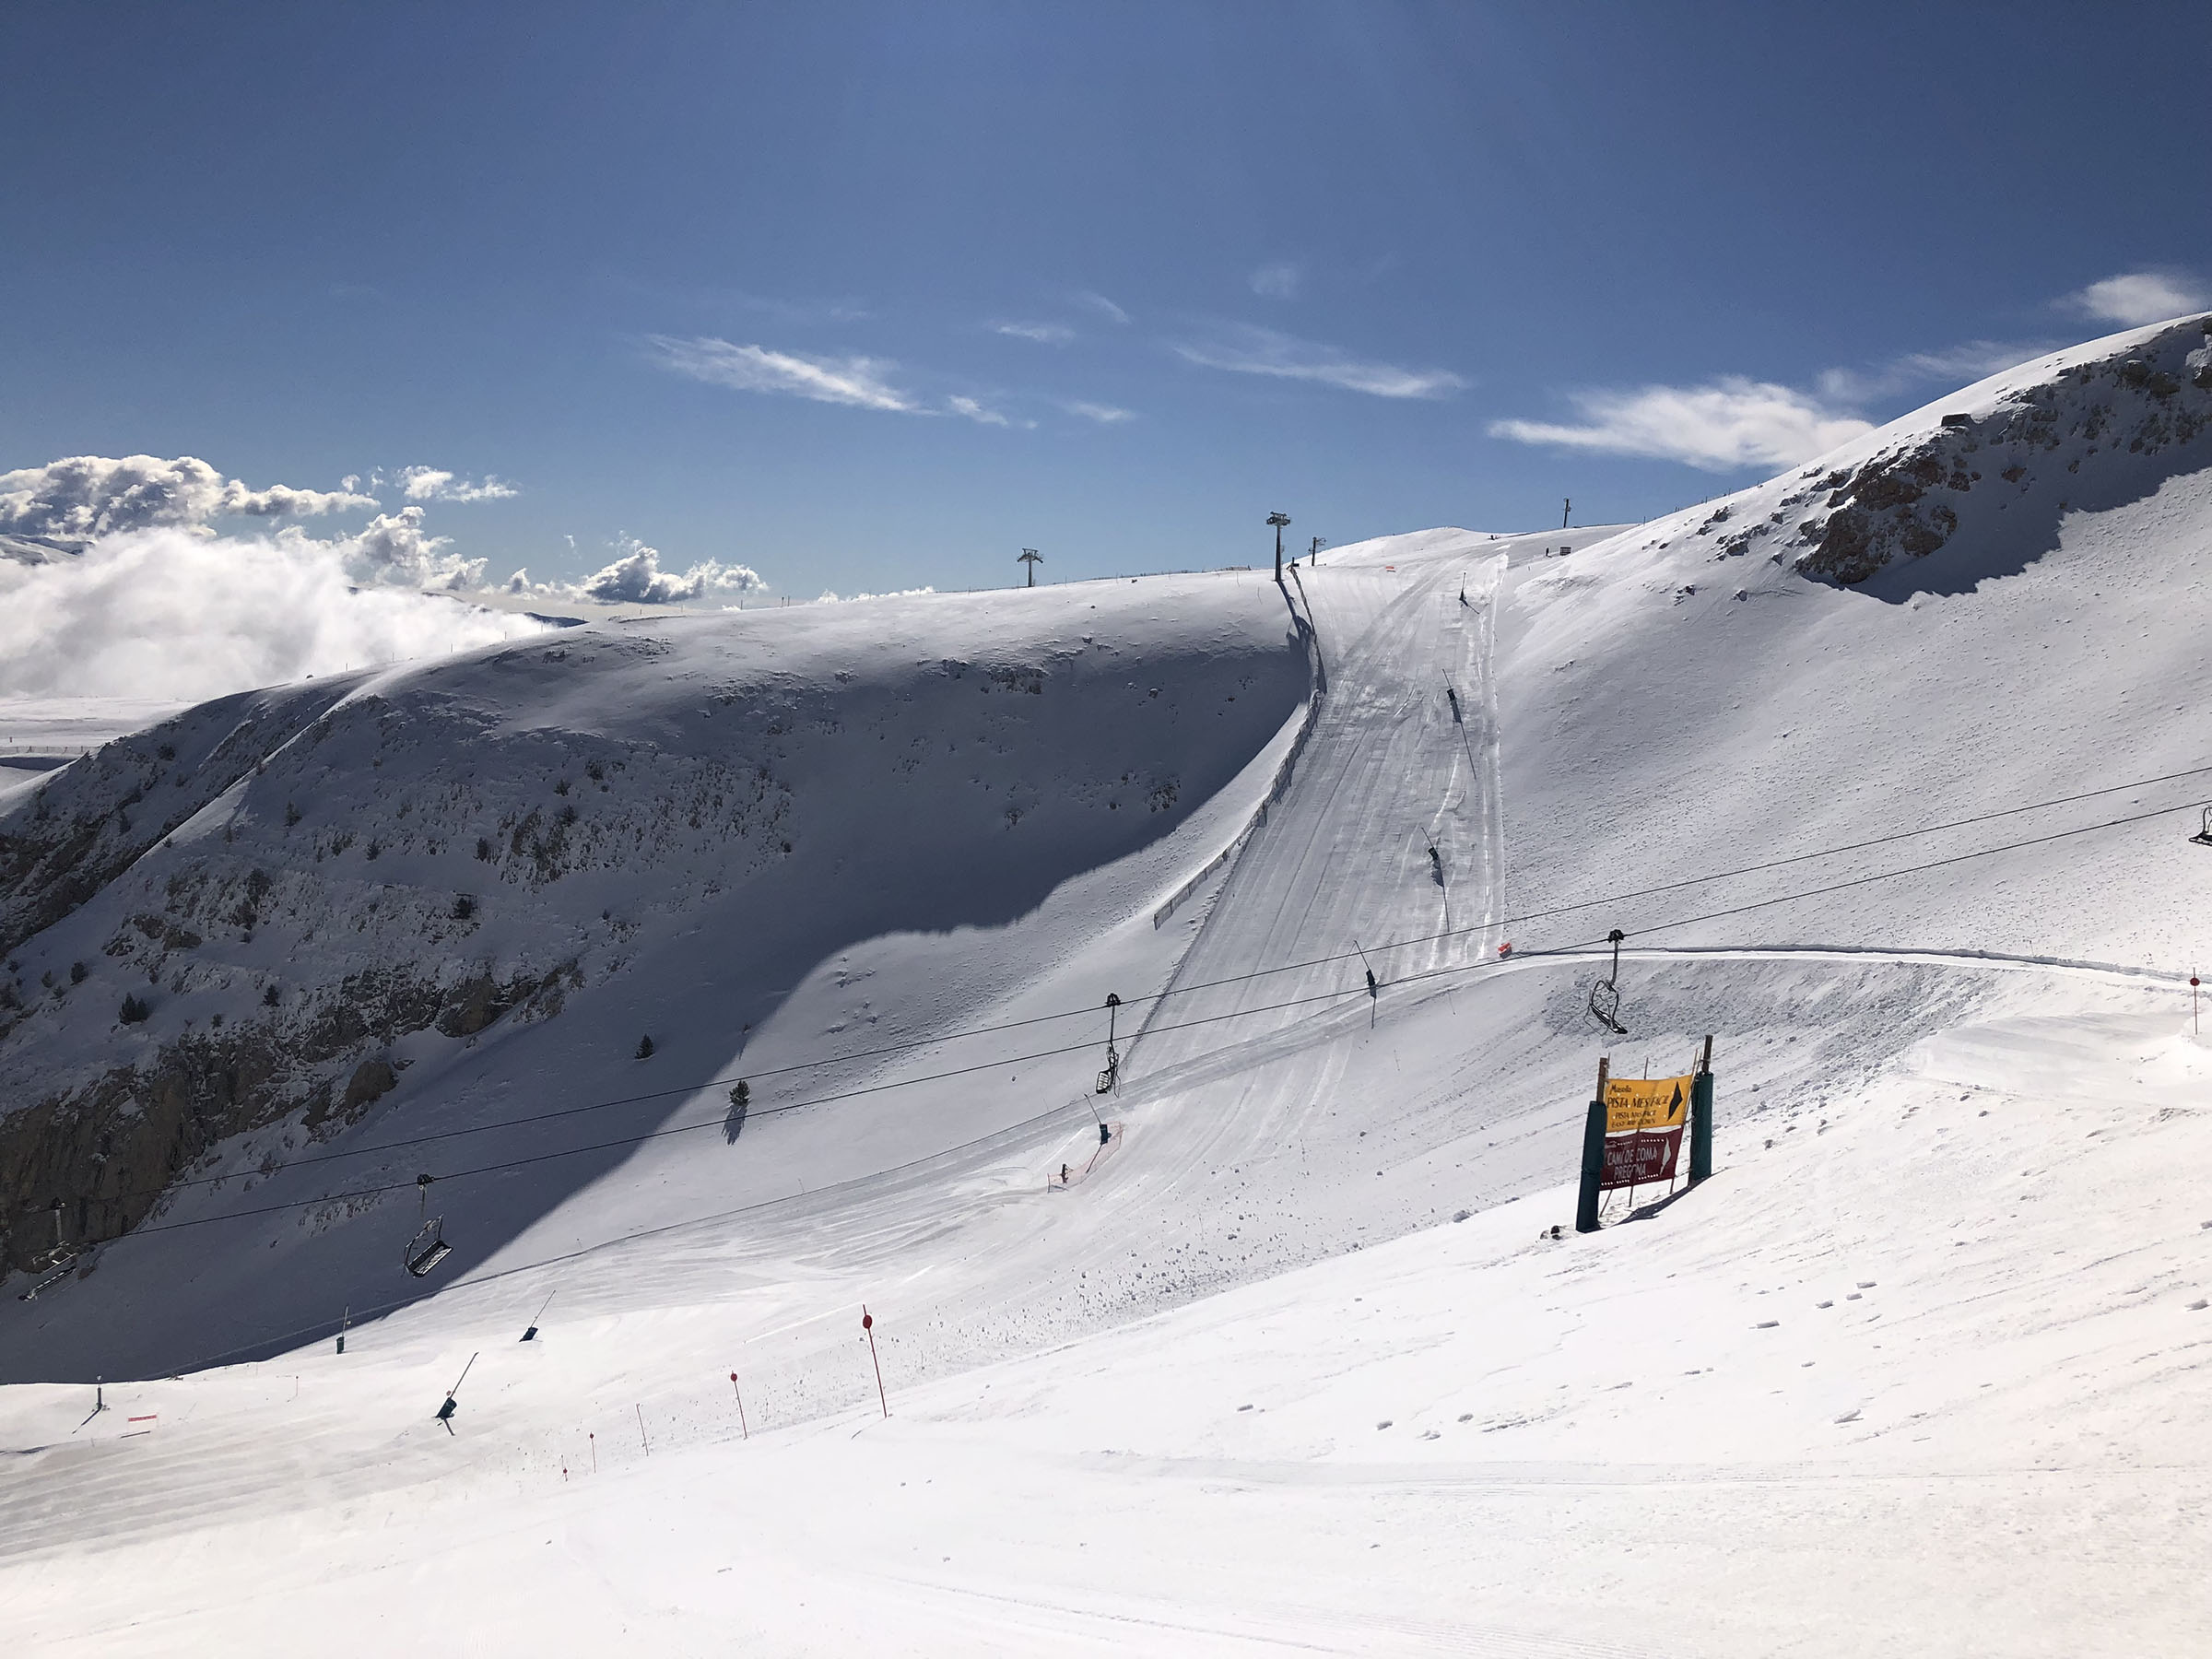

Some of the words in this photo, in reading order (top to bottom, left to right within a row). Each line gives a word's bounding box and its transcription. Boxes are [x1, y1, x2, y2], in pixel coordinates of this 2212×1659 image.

[1607, 1097, 1629, 1108] PISTA
[1625, 1149, 1634, 1163] DE
[1636, 1147, 1658, 1161] COMA
